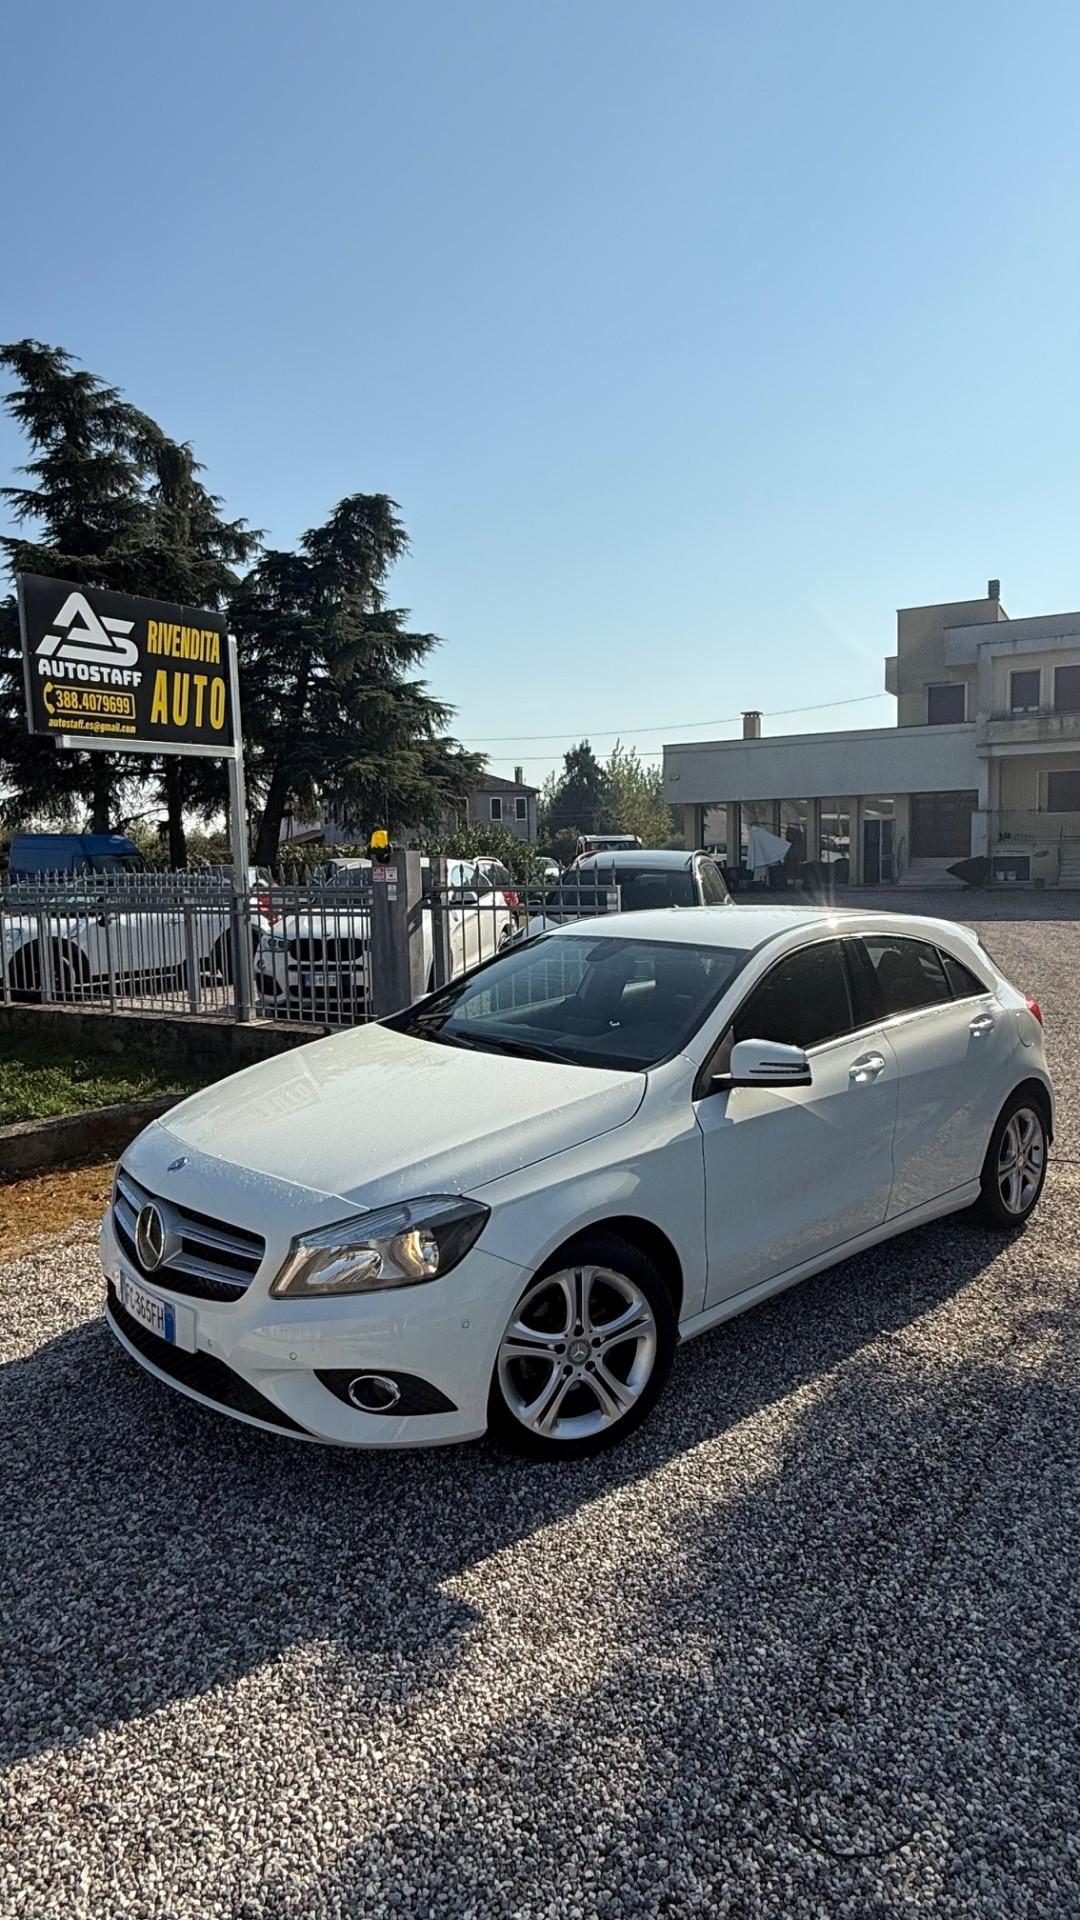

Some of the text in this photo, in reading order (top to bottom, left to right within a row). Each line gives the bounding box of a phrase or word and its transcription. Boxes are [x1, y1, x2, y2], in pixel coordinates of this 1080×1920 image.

[147, 620, 220, 664] RIVENDITA
[38, 659, 142, 687] AUTOSTAFF
[55, 690, 131, 714] 388.4079699
[151, 669, 226, 730] AUTO
[48, 718, 136, 734] autostaff.es@gmail.com
